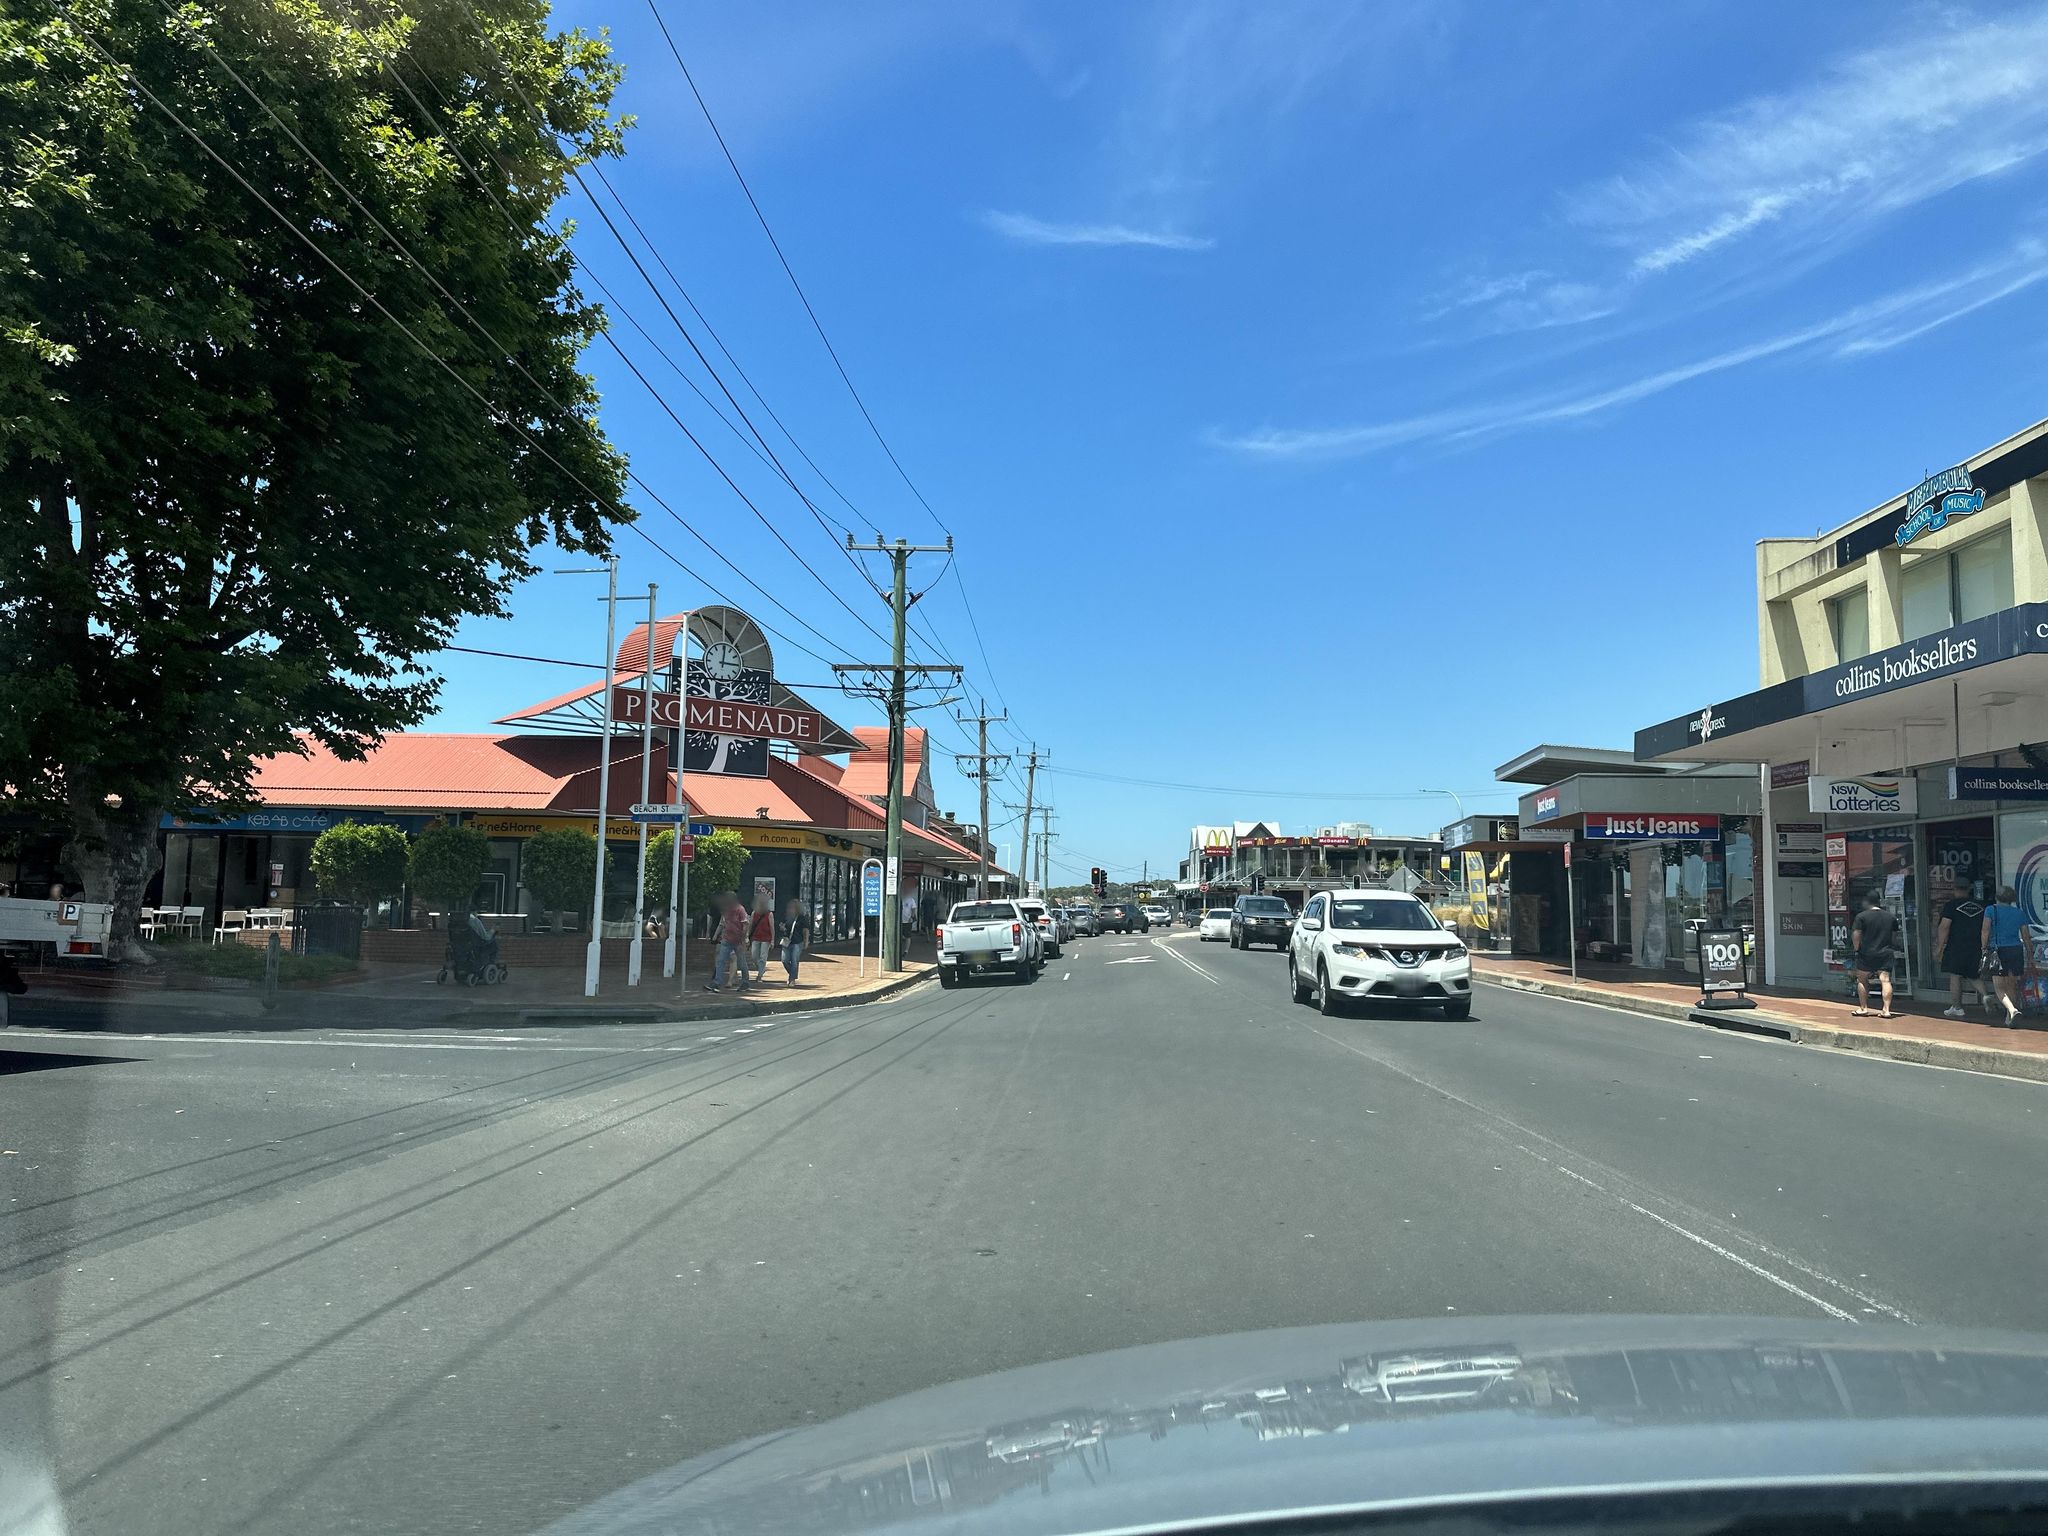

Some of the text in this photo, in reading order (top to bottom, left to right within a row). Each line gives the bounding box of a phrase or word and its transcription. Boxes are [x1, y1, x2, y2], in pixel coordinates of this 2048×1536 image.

[1905, 509, 1932, 536] SCHOOL
[1947, 497, 1972, 510] MUSIC
[1835, 637, 1977, 697] collins booksellers
[625, 694, 811, 737] PROMENADE
[1831, 785, 1860, 795] NSW
[1964, 778, 1997, 790] collins
[633, 805, 657, 813] BEACH
[1829, 795, 1900, 812] Lotteries
[1605, 817, 1700, 836] Just Jeans
[760, 833, 801, 845] rh.com.au
[65, 905, 76, 919] P
